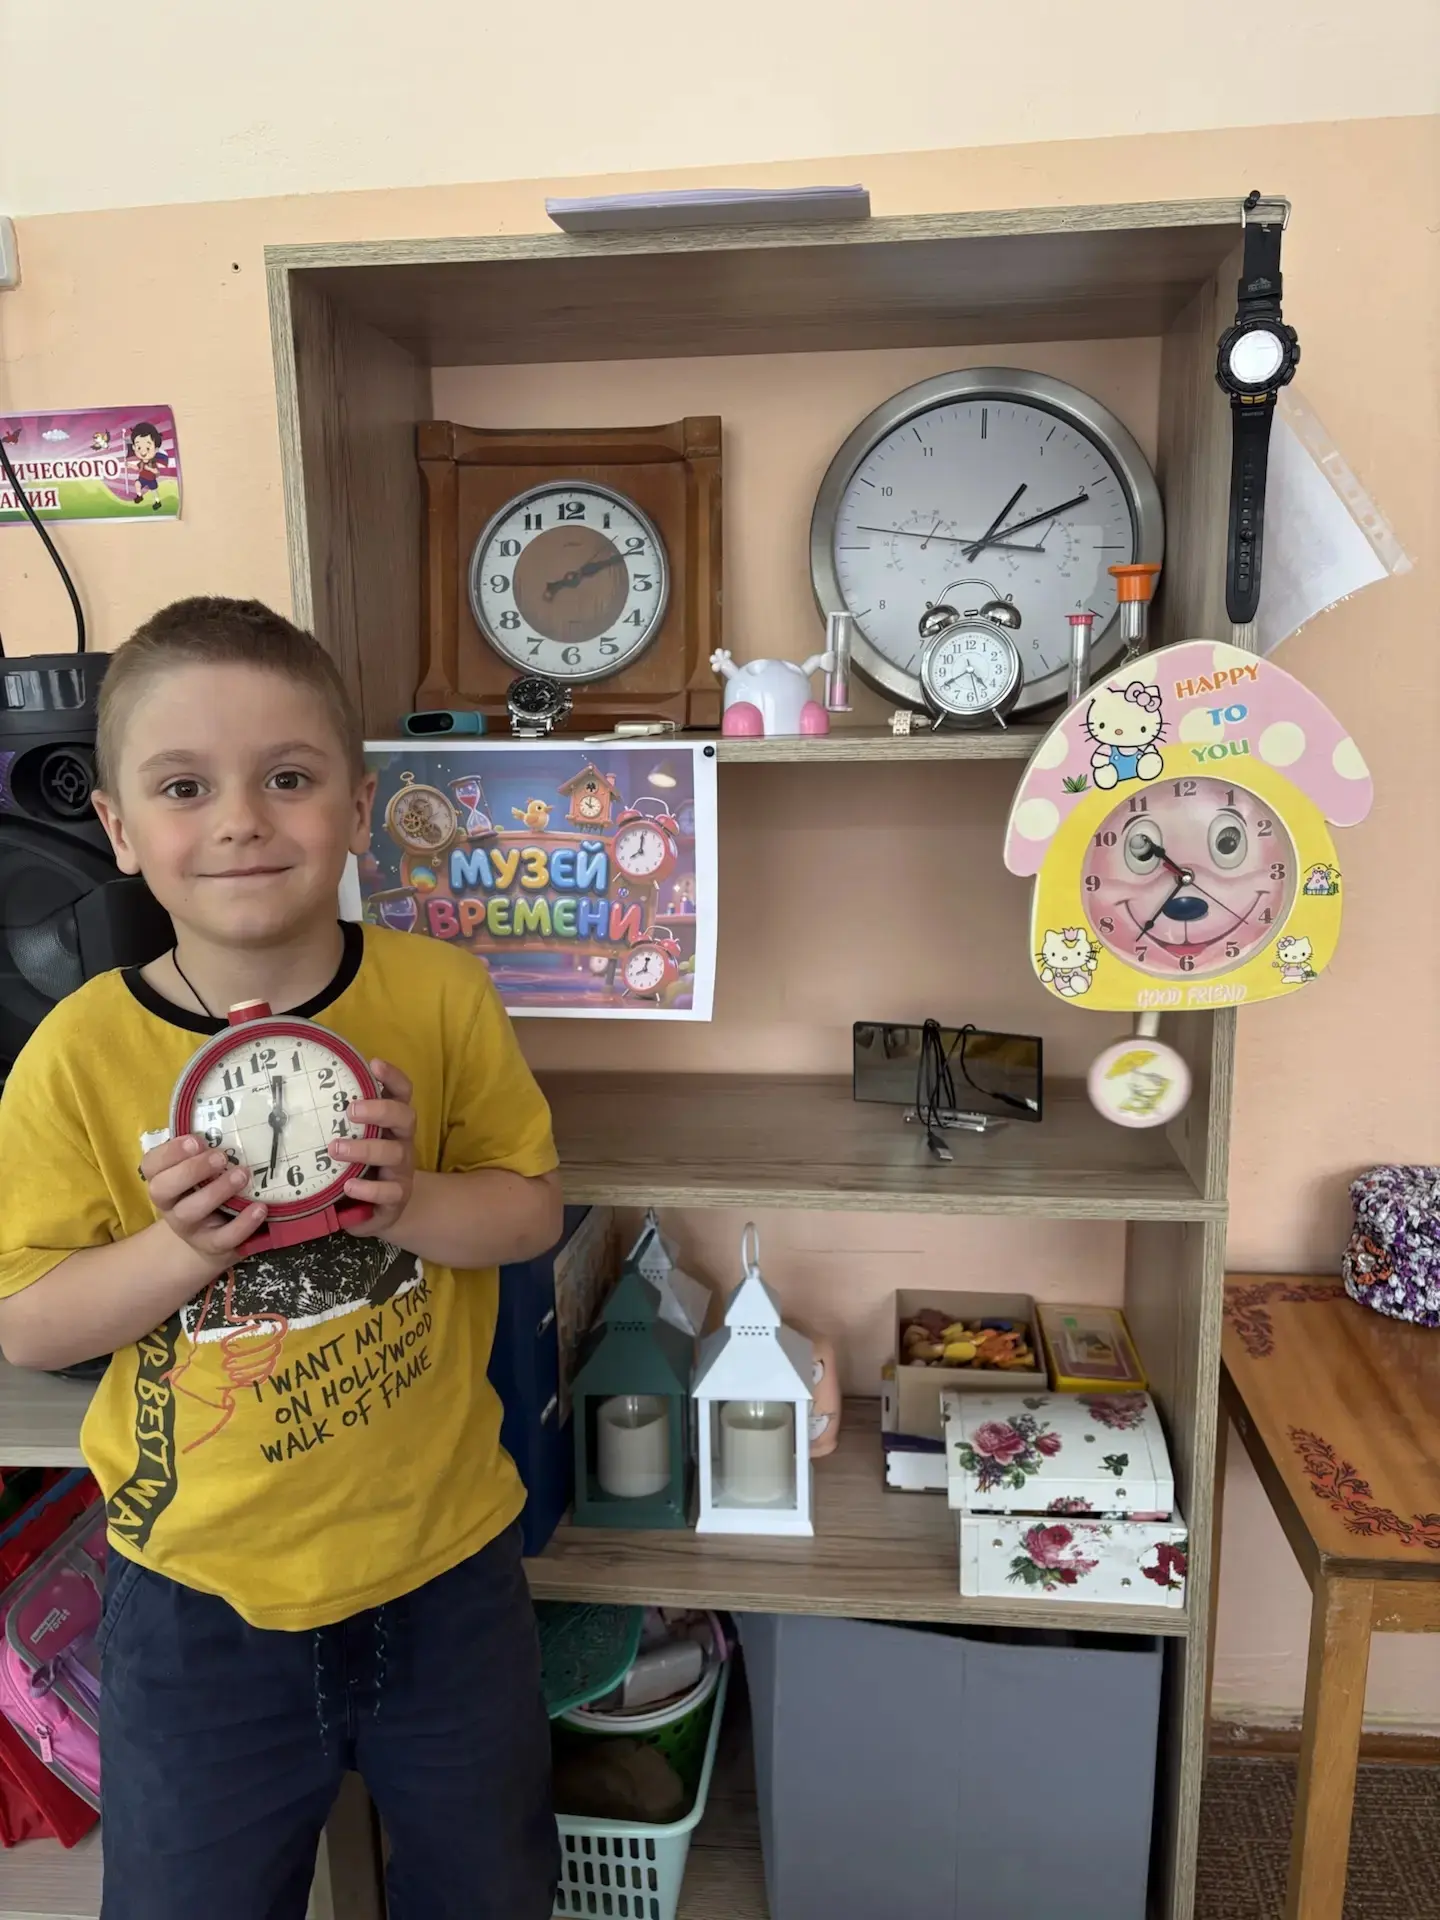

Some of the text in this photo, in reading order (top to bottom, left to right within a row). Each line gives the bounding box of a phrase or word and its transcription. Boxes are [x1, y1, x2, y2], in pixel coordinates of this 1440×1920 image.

[923, 447, 933, 457] 11
[880, 486, 893, 497] 10
[1078, 485, 1086, 496] 2
[557, 502, 585, 520] 12
[524, 513, 543, 530] 11
[602, 512, 611, 529] 1
[500, 539, 522, 557] 10
[625, 537, 645, 556] 2
[490, 575, 510, 593] 9
[632, 574, 653, 592] 3
[879, 600, 886, 610] 8
[1075, 600, 1082, 610] 4
[499, 611, 521, 629] 8
[623, 609, 645, 626] 4
[526, 637, 545, 655] 7
[599, 637, 620, 655] 5
[953, 644, 961, 654] 11
[965, 640, 976, 650] 12
[982, 642, 987, 652] 1
[1032, 639, 1039, 649] 5
[561, 646, 582, 665] 6
[943, 654, 953, 664] 10
[991, 651, 998, 661] 2
[939, 667, 946, 677] 9
[995, 664, 1002, 675] 3
[989, 678, 996, 687] 4
[1175, 663, 1259, 699] HAPPY
[954, 690, 960, 699] 7
[966, 692, 974, 702] 6
[980, 688, 987, 698] 5
[1207, 704, 1248, 726] TO
[1191, 740, 1250, 762] YOU
[1173, 781, 1197, 797] 12
[1128, 797, 1148, 812] 11
[1225, 790, 1235, 806] 1
[1257, 820, 1273, 837] 2
[1094, 831, 1117, 847] 10
[450, 839, 609, 893] МУЗЕЙ
[1270, 863, 1285, 880] 3
[1085, 875, 1101, 891] 9
[427, 897, 645, 940] ВРЕМЕНИ
[1258, 908, 1273, 924] 4
[1100, 917, 1114, 933] 8
[1135, 946, 1148, 962] 7
[1225, 942, 1240, 958] 5
[1179, 955, 1195, 971] 6
[1137, 984, 1247, 1008] GOOD FRIEND
[250, 1049, 278, 1074] 12
[290, 1051, 301, 1072] 1
[222, 1066, 244, 1091] 11
[318, 1068, 336, 1090] 2
[333, 1091, 349, 1112] 3
[332, 1119, 349, 1137] 4
[205, 1127, 223, 1148] 9
[315, 1149, 331, 1171] 5
[253, 1167, 269, 1189] 7
[286, 1165, 304, 1187] 6
[253, 1278, 432, 1402] I WANT MY STAR
[275, 1312, 432, 1425] ON HOLLYWOOD
[260, 1346, 432, 1463] WALK OF FAME
[137, 1377, 172, 1480] BEST
